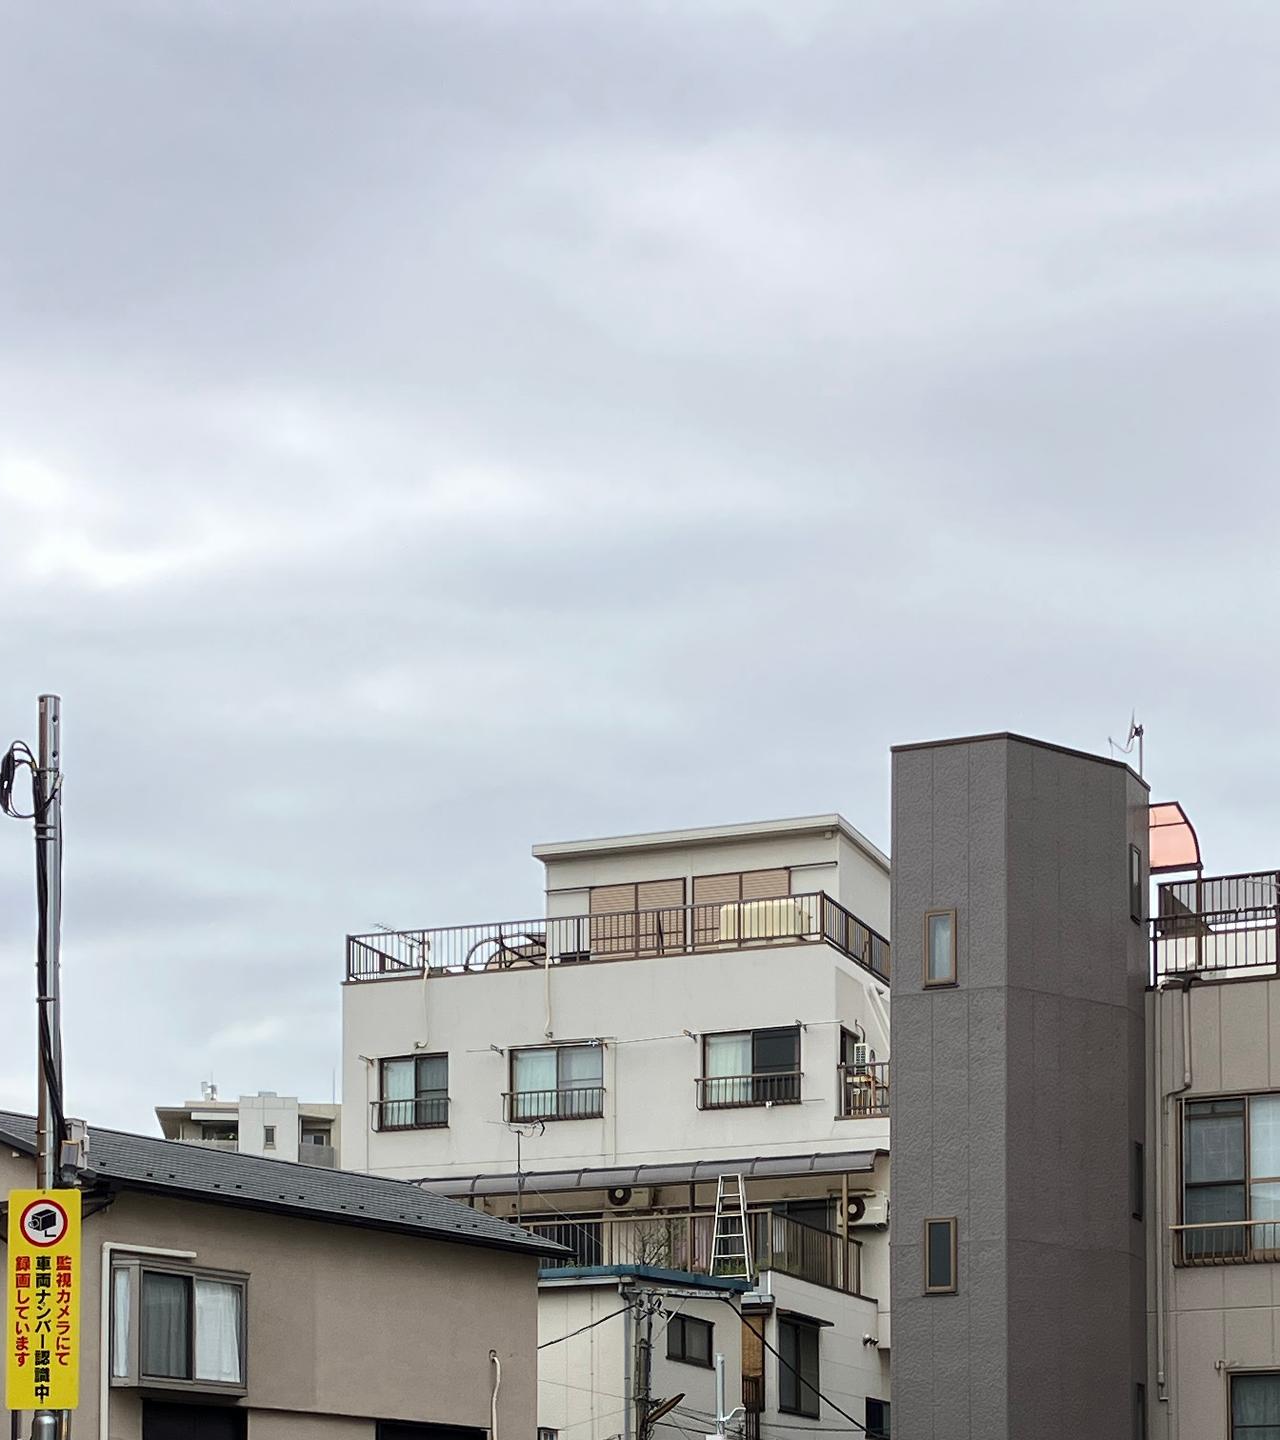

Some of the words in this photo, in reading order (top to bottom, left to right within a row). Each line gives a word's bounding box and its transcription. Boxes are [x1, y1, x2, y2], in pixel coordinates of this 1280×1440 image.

[15, 1255, 30, 1367] 録画しています
[34, 1255, 52, 1403] 車両ナンバー認識中
[55, 1255, 72, 1366] 監視カメラにて
